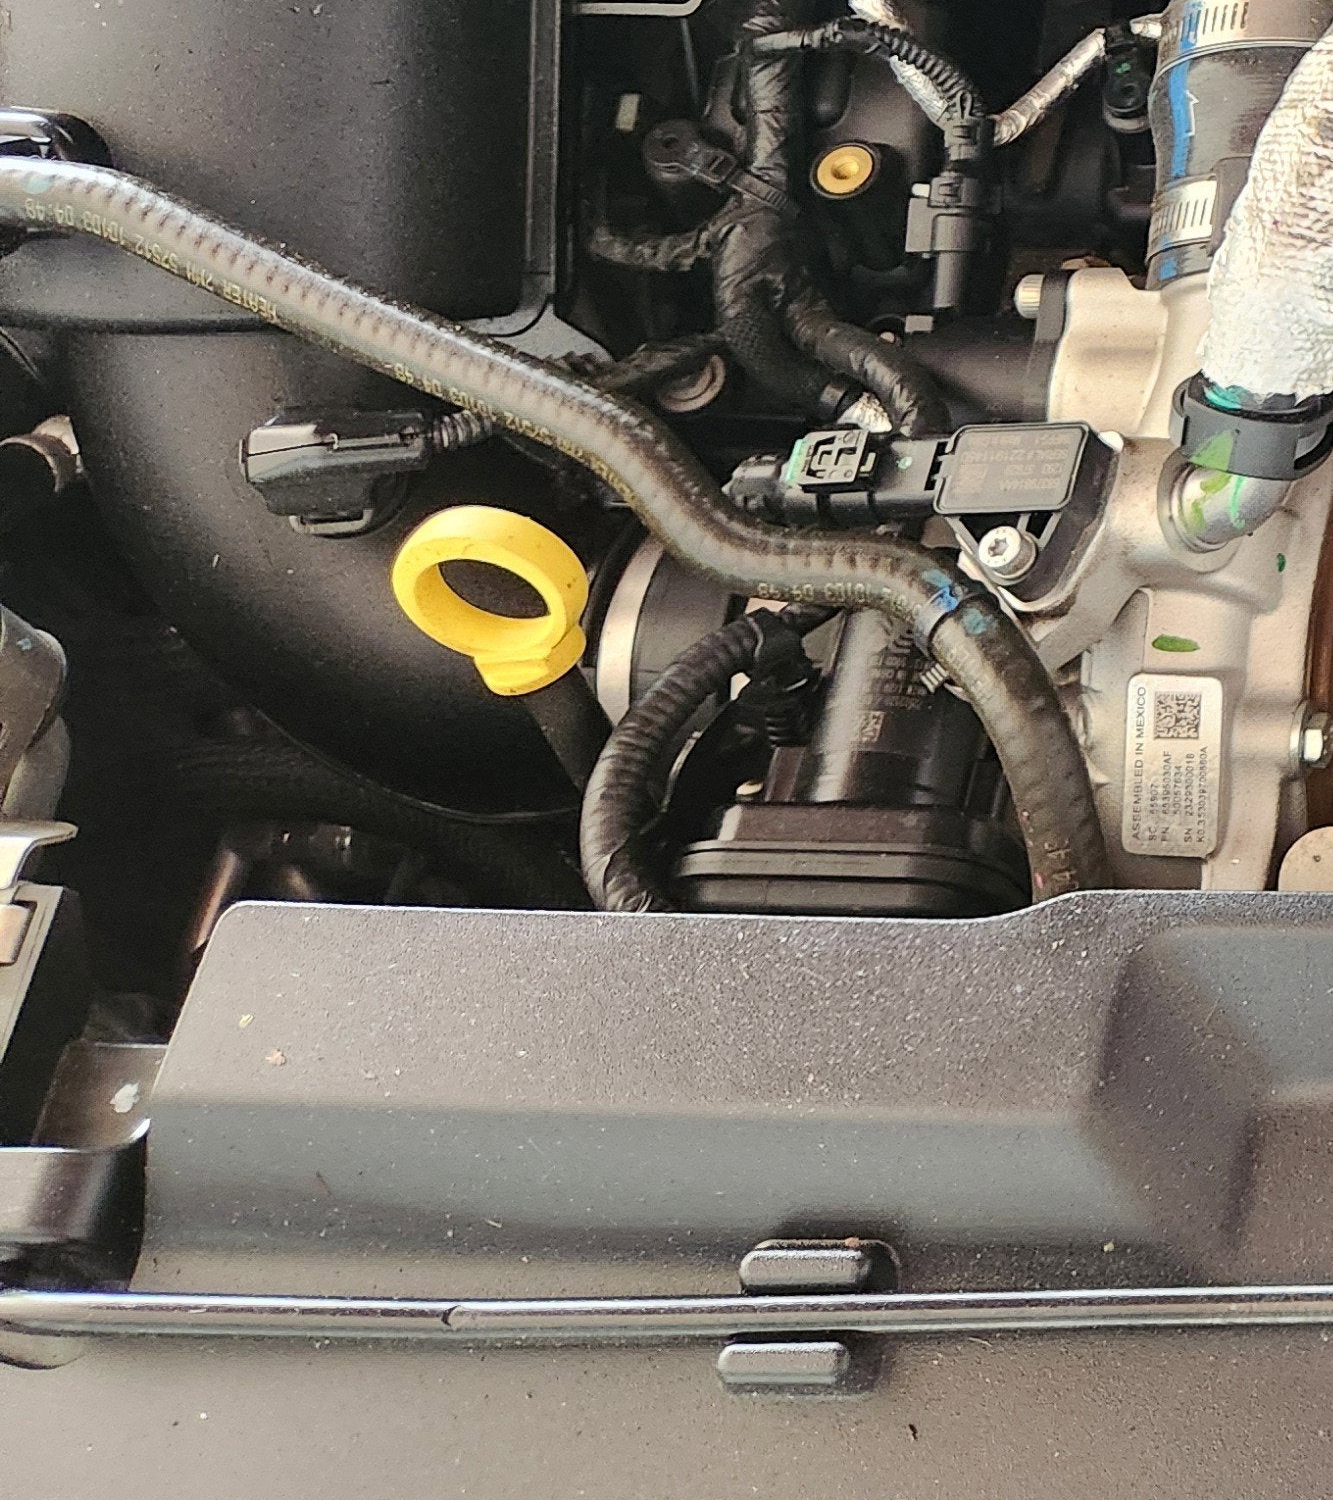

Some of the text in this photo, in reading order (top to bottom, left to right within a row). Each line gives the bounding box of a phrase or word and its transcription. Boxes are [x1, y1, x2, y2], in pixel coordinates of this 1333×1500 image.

[1131, 686, 1146, 840] ASSEMBLED IN MEXICO
